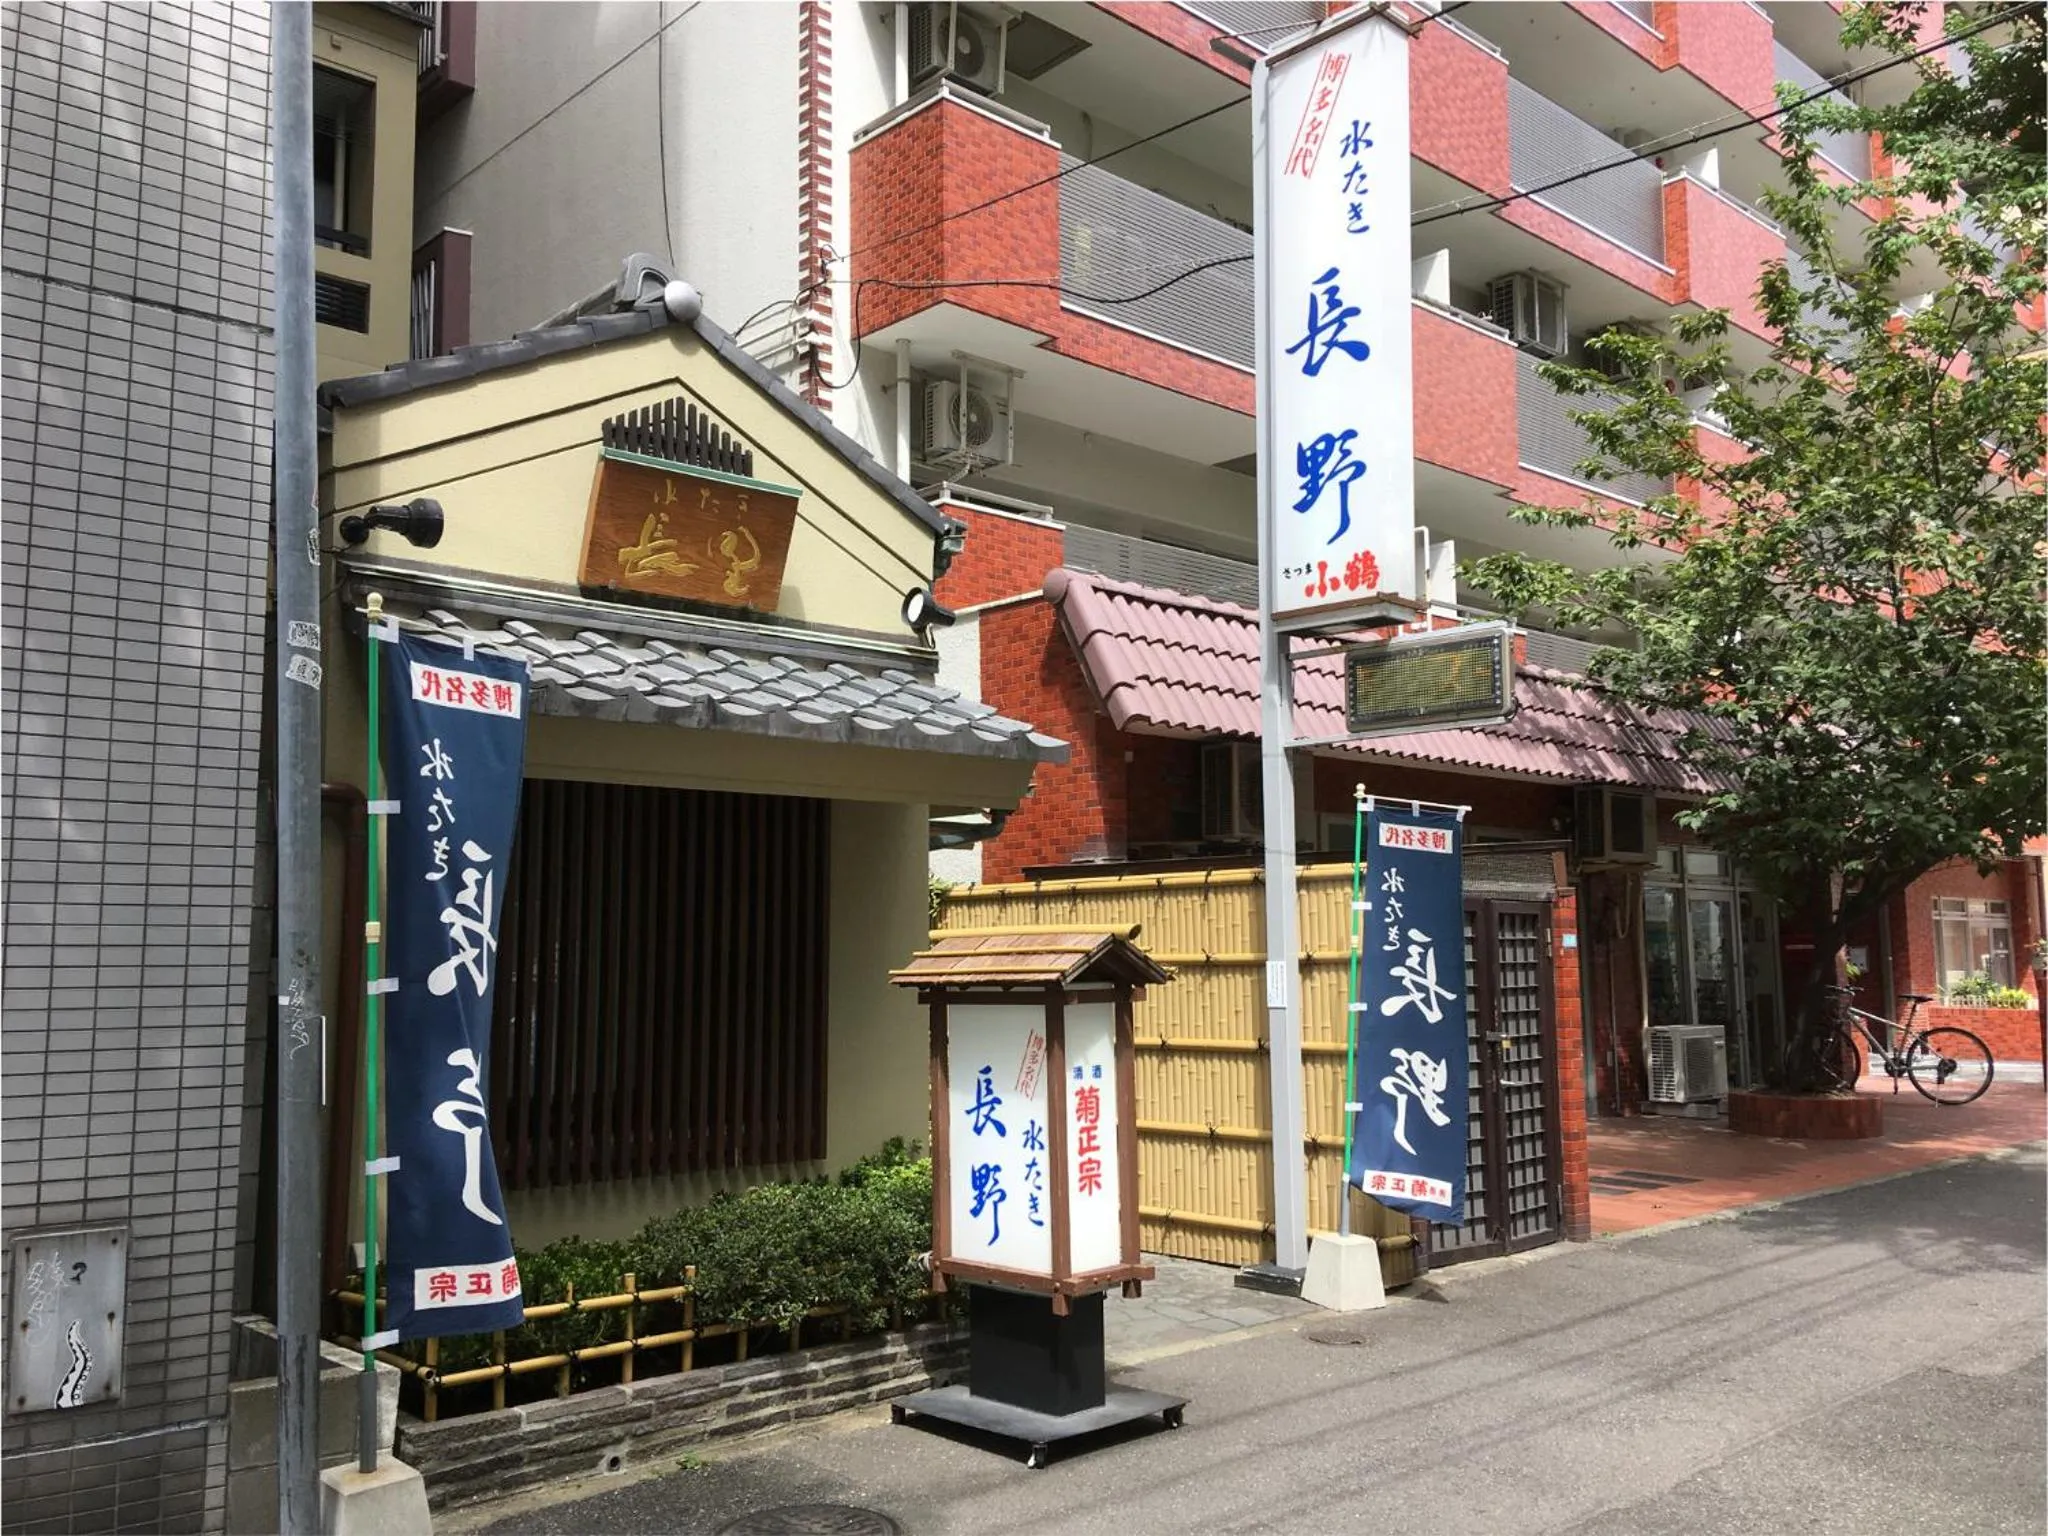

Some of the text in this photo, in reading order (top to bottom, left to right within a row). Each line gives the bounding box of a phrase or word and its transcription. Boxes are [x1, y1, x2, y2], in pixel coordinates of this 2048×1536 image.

[1290, 53, 1343, 178] 博多名代
[1340, 120, 1374, 234] 水たき
[1286, 267, 1371, 545] 長野
[1283, 550, 1380, 597] さつま 小鶴
[965, 1065, 1007, 1246] 長野
[1022, 1120, 1045, 1226] 水たき
[1075, 1085, 1102, 1196] 菊正宗
